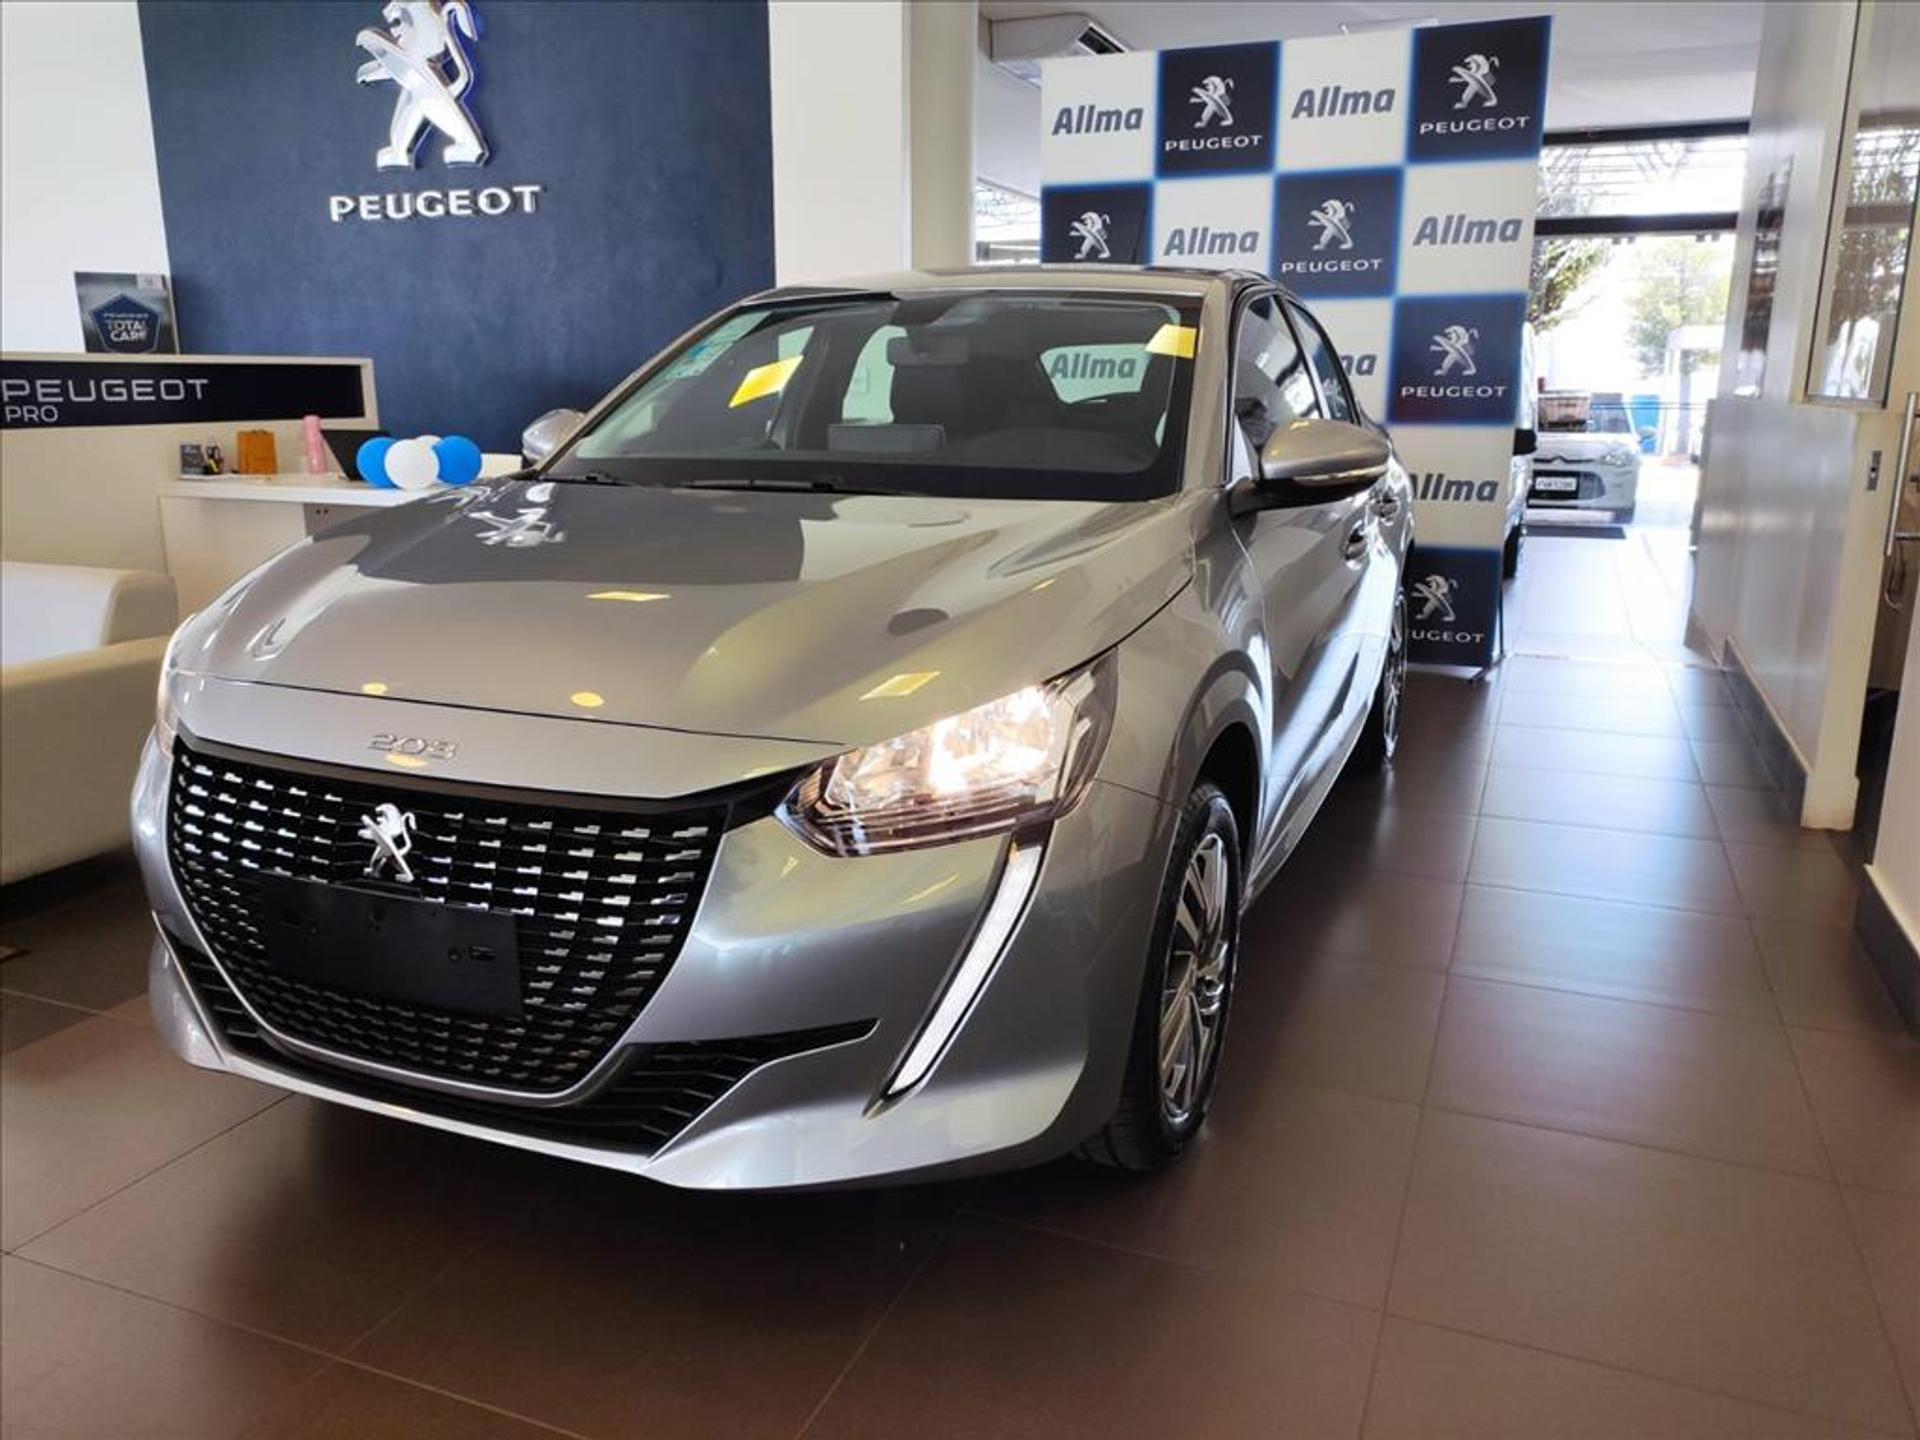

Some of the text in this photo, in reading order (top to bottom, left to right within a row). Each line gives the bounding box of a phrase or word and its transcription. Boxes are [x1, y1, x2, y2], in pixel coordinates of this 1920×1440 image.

[1291, 86, 1395, 119] Allma
[1052, 105, 1144, 136] Allma
[1419, 116, 1530, 135] PEUGEOT
[1164, 135, 1263, 151] PEUGEOT
[329, 185, 541, 222] PEUGEOT
[1163, 227, 1259, 256] Allma
[1412, 214, 1523, 246] Allma
[1281, 258, 1383, 273] PEUGEOT
[1050, 353, 1137, 379] Allma
[1, 379, 209, 404] PEUGEOT
[1400, 385, 1507, 398] PEUGEOT
[5, 405, 59, 423] PRO
[1411, 629, 1484, 643] UGEOT
